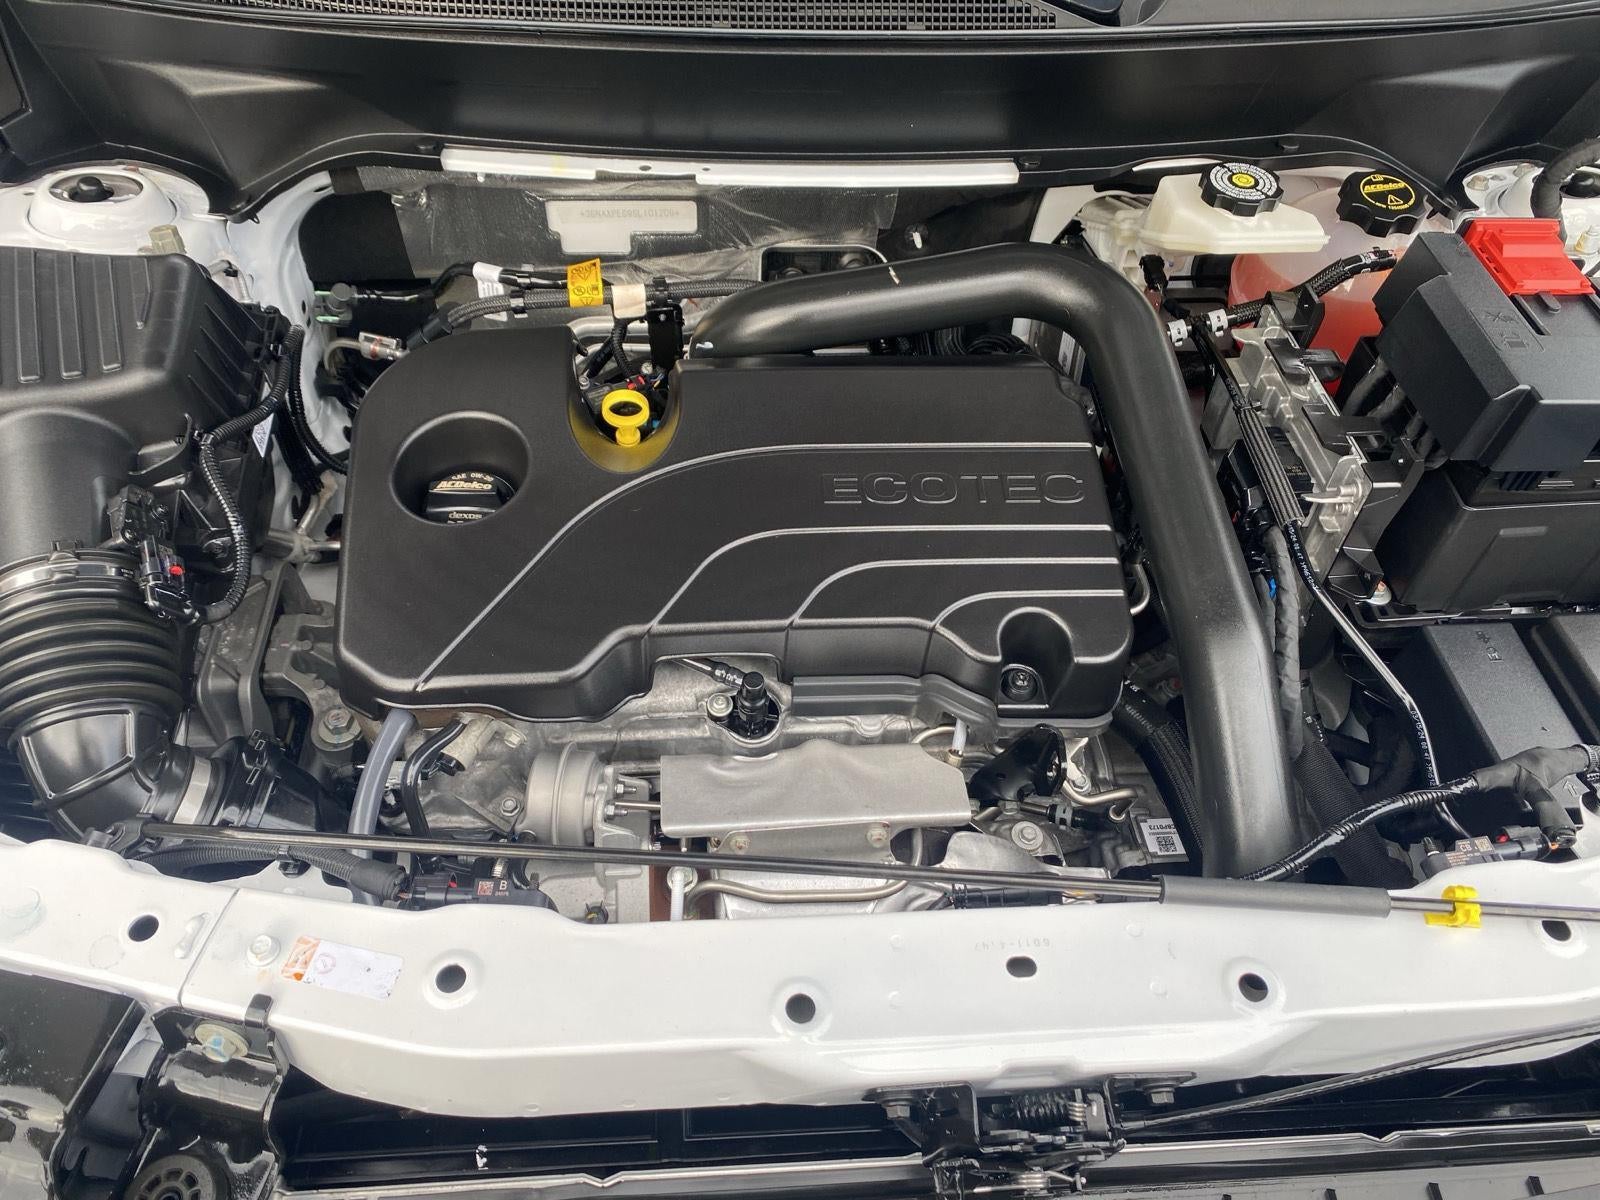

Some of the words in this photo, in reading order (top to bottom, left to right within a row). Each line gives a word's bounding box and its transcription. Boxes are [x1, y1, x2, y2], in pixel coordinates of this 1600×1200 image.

[435, 480, 493, 491] ACDelco
[821, 472, 1085, 504] ECOTEC
[499, 880, 508, 891] B
